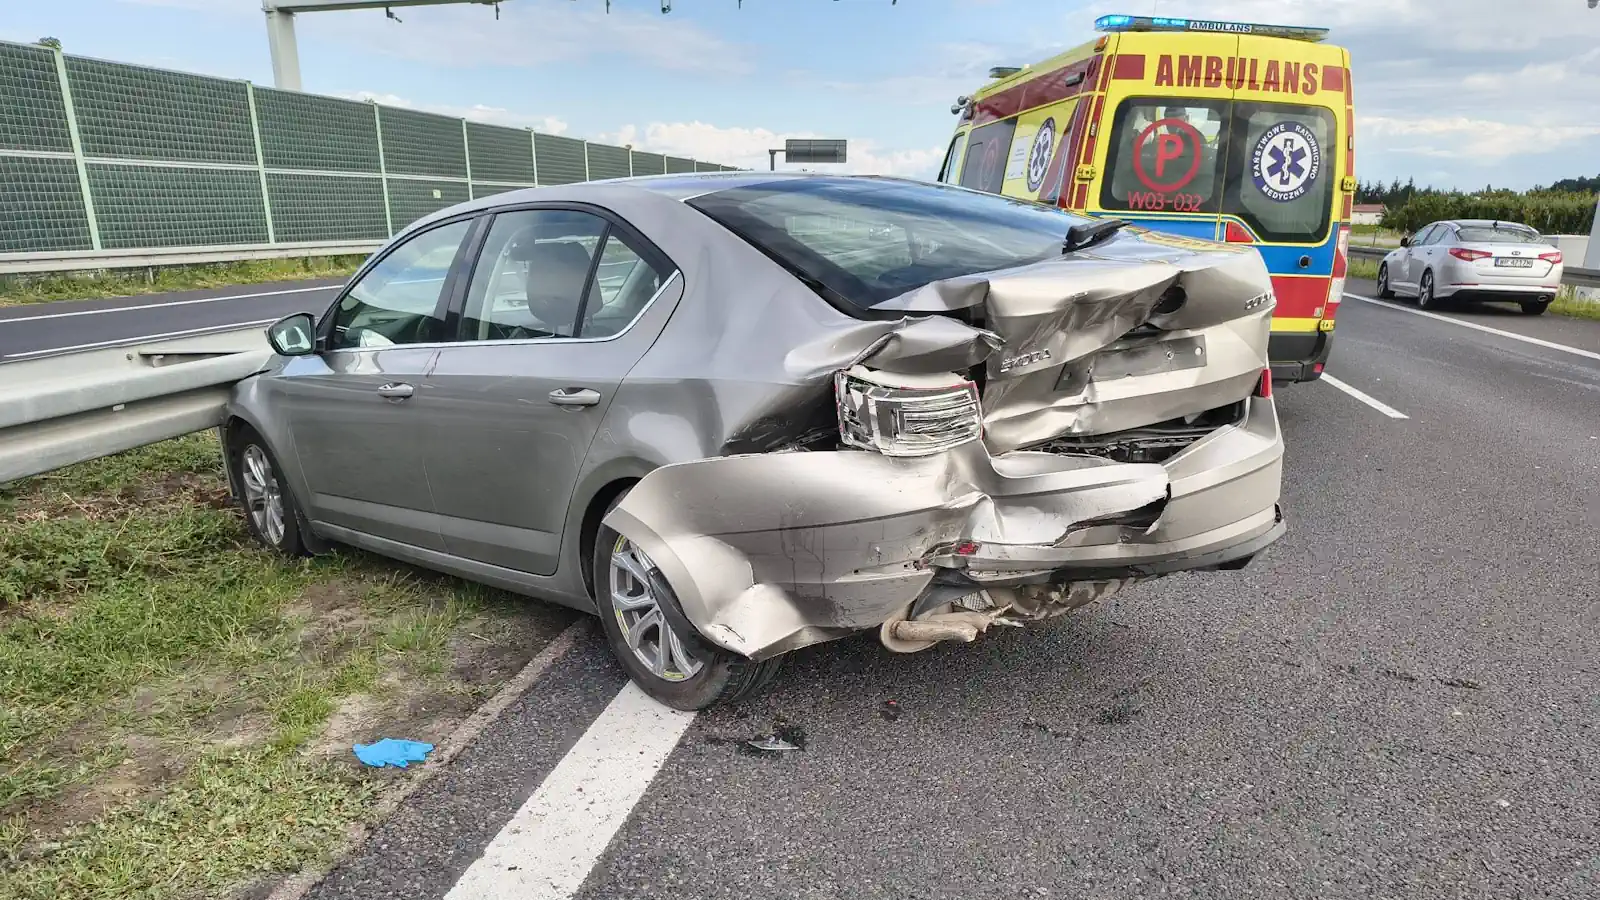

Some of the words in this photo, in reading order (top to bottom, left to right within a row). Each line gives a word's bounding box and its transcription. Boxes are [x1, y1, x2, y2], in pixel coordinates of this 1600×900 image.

[1191, 22, 1251, 32] AMBULANS
[1155, 54, 1318, 95] AMBULANS
[1155, 133, 1184, 177] P
[1295, 124, 1319, 180] RATOWNICTWO
[1127, 190, 1202, 212] W03-032
[1261, 184, 1305, 200] MEDYCZNE
